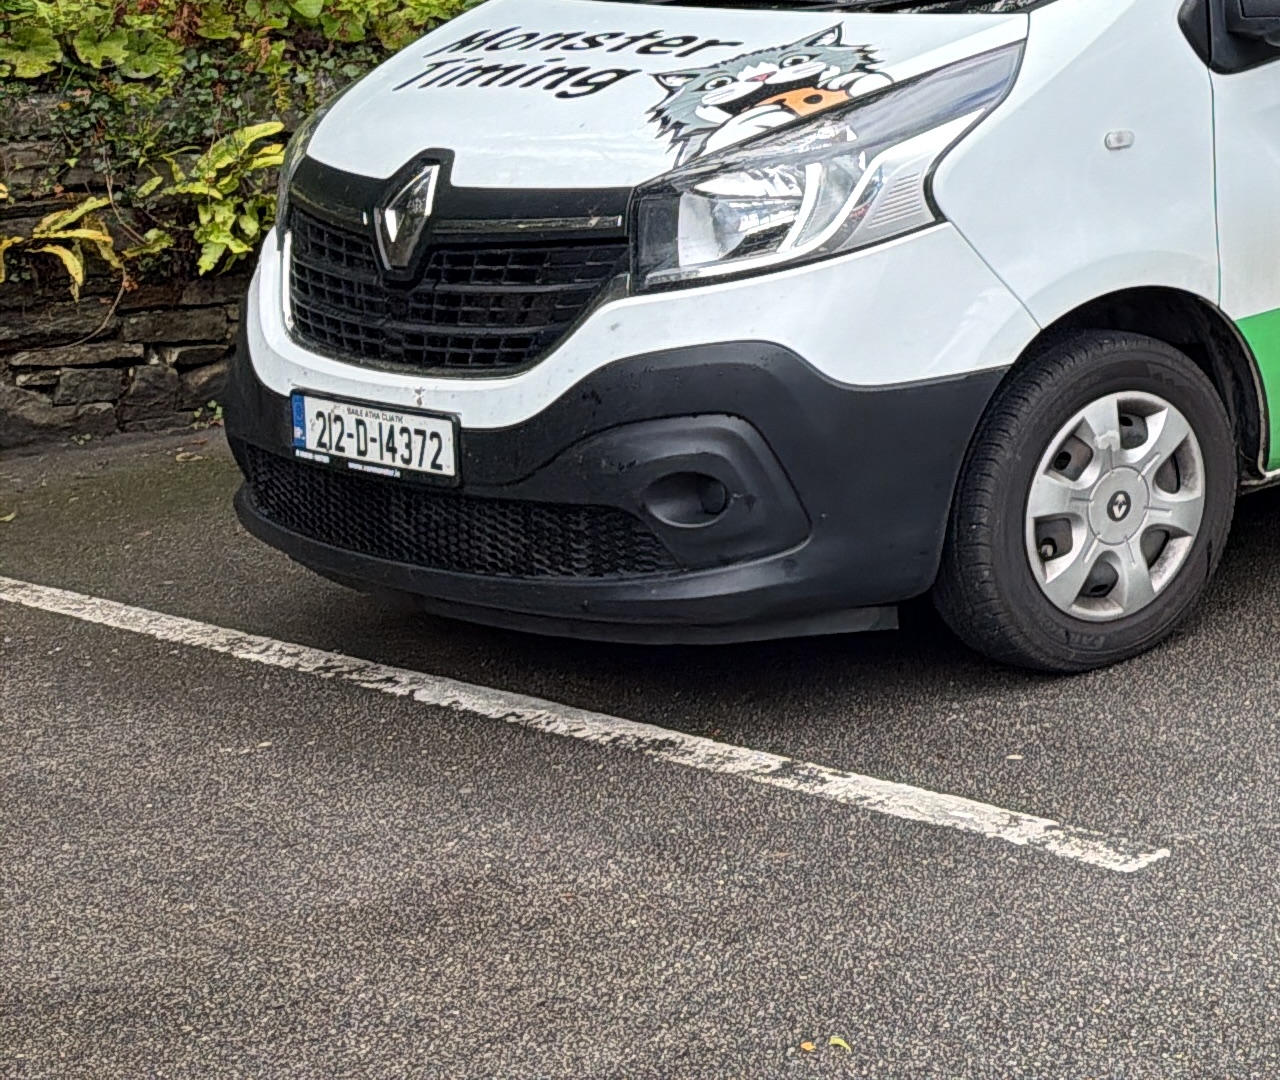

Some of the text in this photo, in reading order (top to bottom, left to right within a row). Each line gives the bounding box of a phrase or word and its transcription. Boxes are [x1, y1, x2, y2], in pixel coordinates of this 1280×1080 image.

[423, 25, 745, 58] Monster
[392, 57, 643, 99] Timing
[315, 410, 443, 471] 212-D-14372
